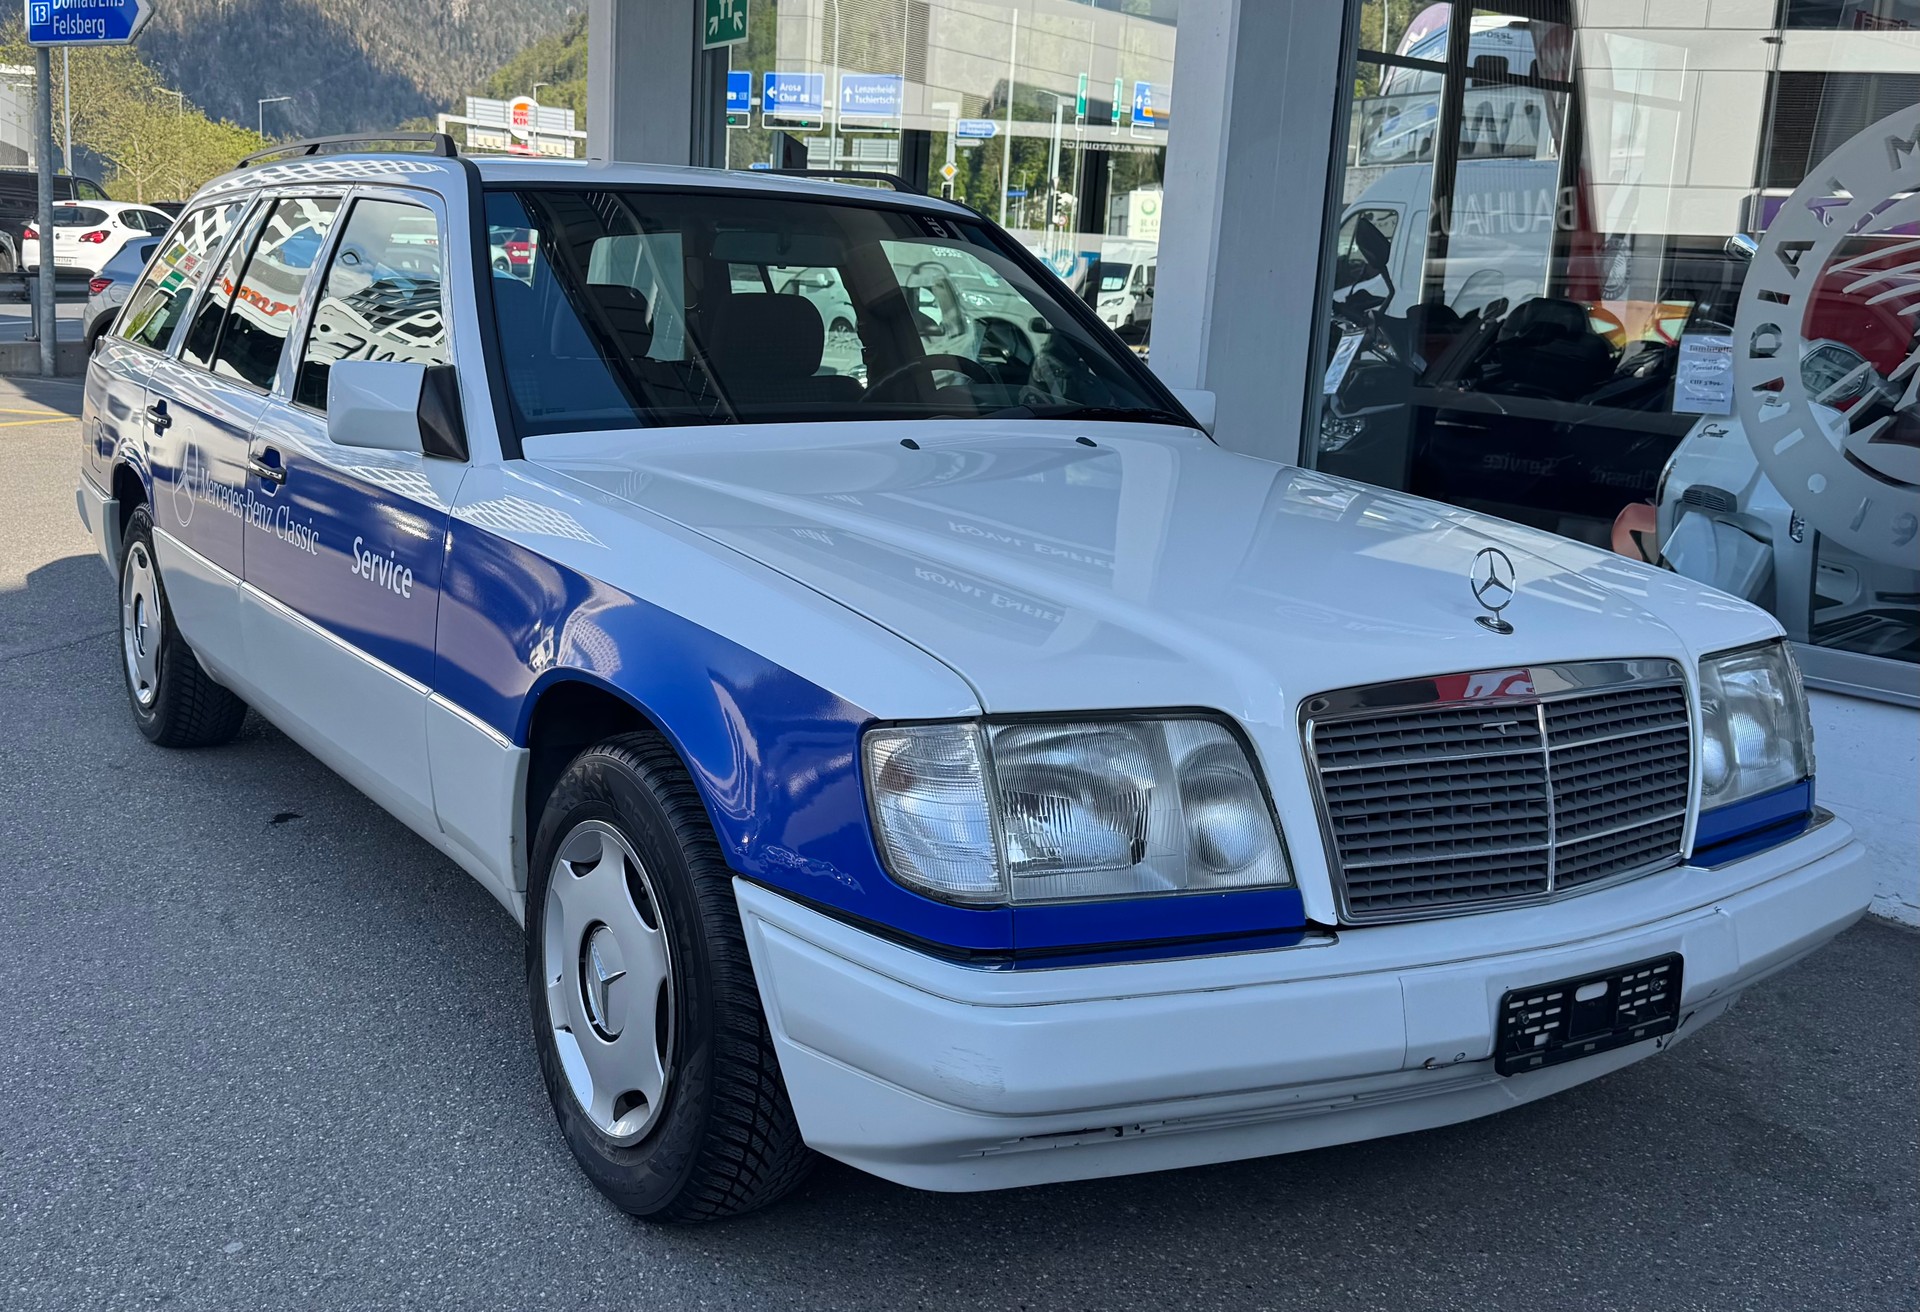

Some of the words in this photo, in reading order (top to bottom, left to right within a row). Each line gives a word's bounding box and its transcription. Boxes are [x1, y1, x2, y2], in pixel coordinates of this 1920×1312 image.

[34, 6, 46, 22] 13
[53, 13, 105, 39] Felsberg
[779, 82, 802, 92] Arosa
[779, 93, 797, 102] Chur
[199, 467, 273, 533] Mercedes-Benz
[275, 504, 320, 556] Classic
[351, 536, 413, 599] Service
